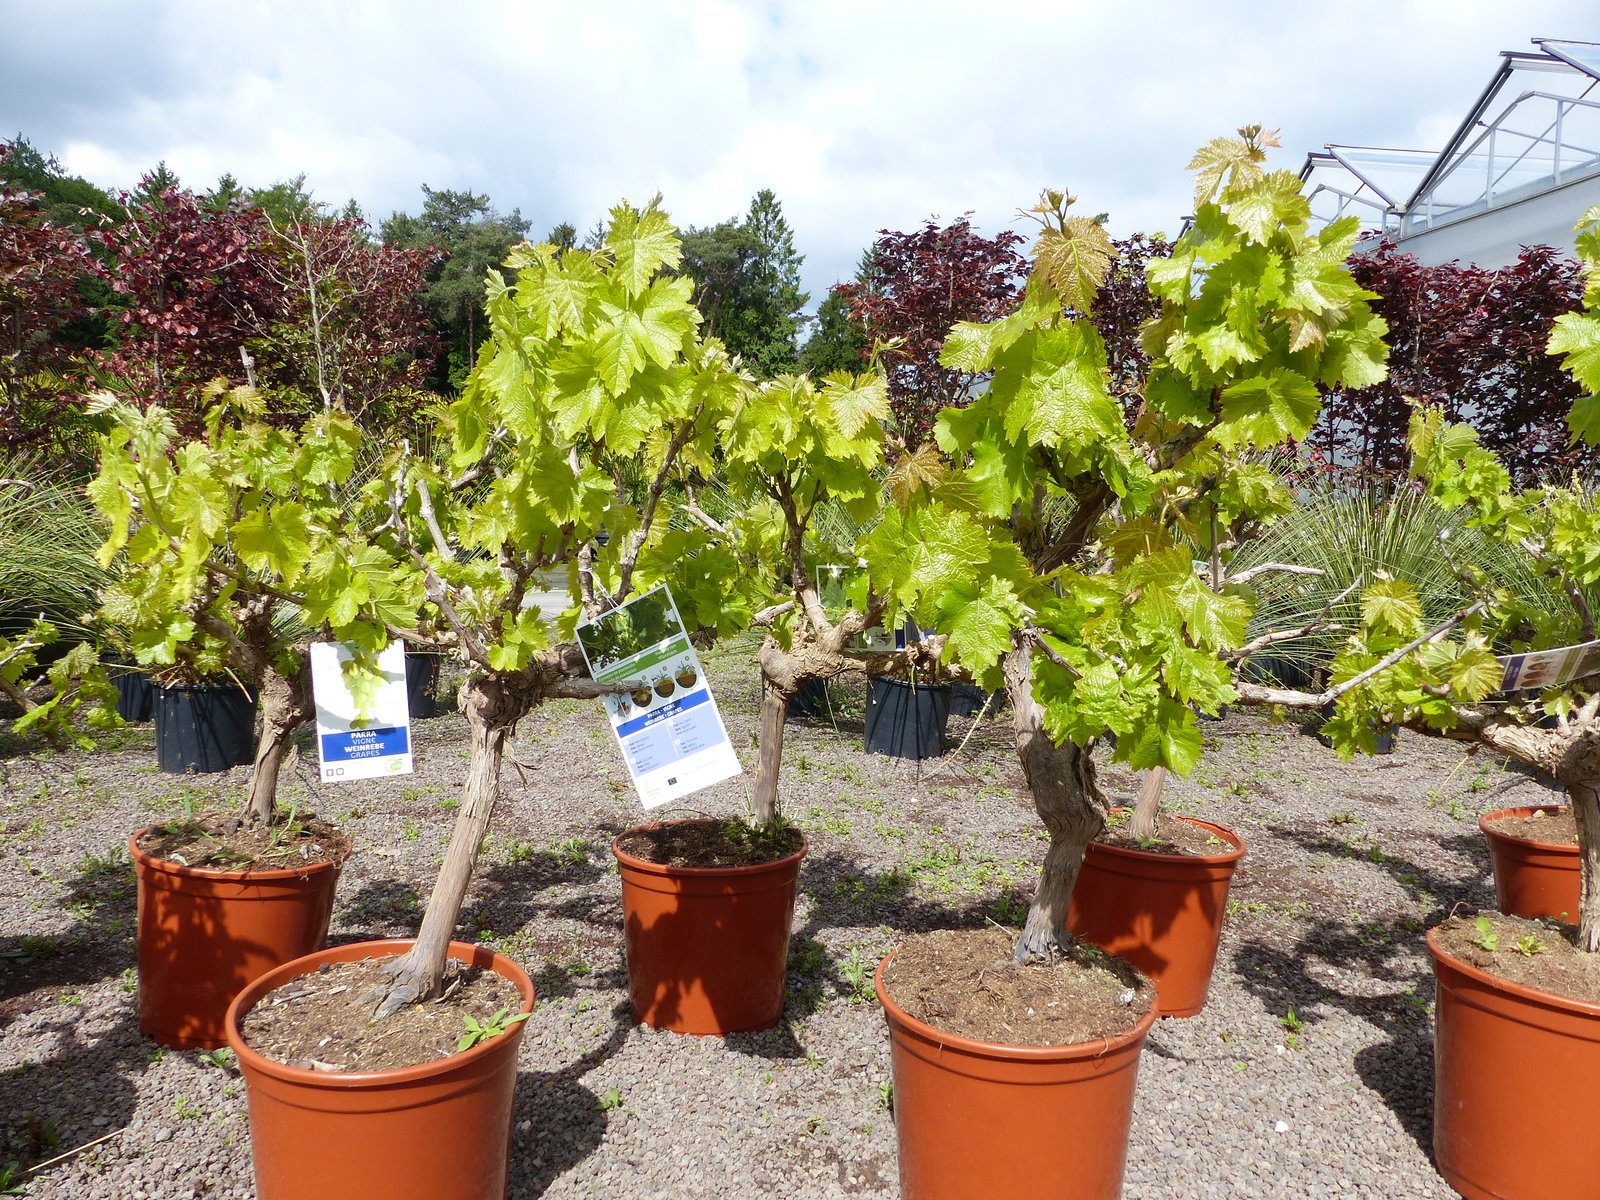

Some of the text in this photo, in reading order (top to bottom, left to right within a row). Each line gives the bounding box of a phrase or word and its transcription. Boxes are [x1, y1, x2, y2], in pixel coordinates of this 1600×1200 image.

[351, 731, 377, 739] PARRA
[352, 737, 377, 745] VIGNE
[344, 743, 385, 753] WEINREBE
[350, 750, 380, 759] GRAPES
